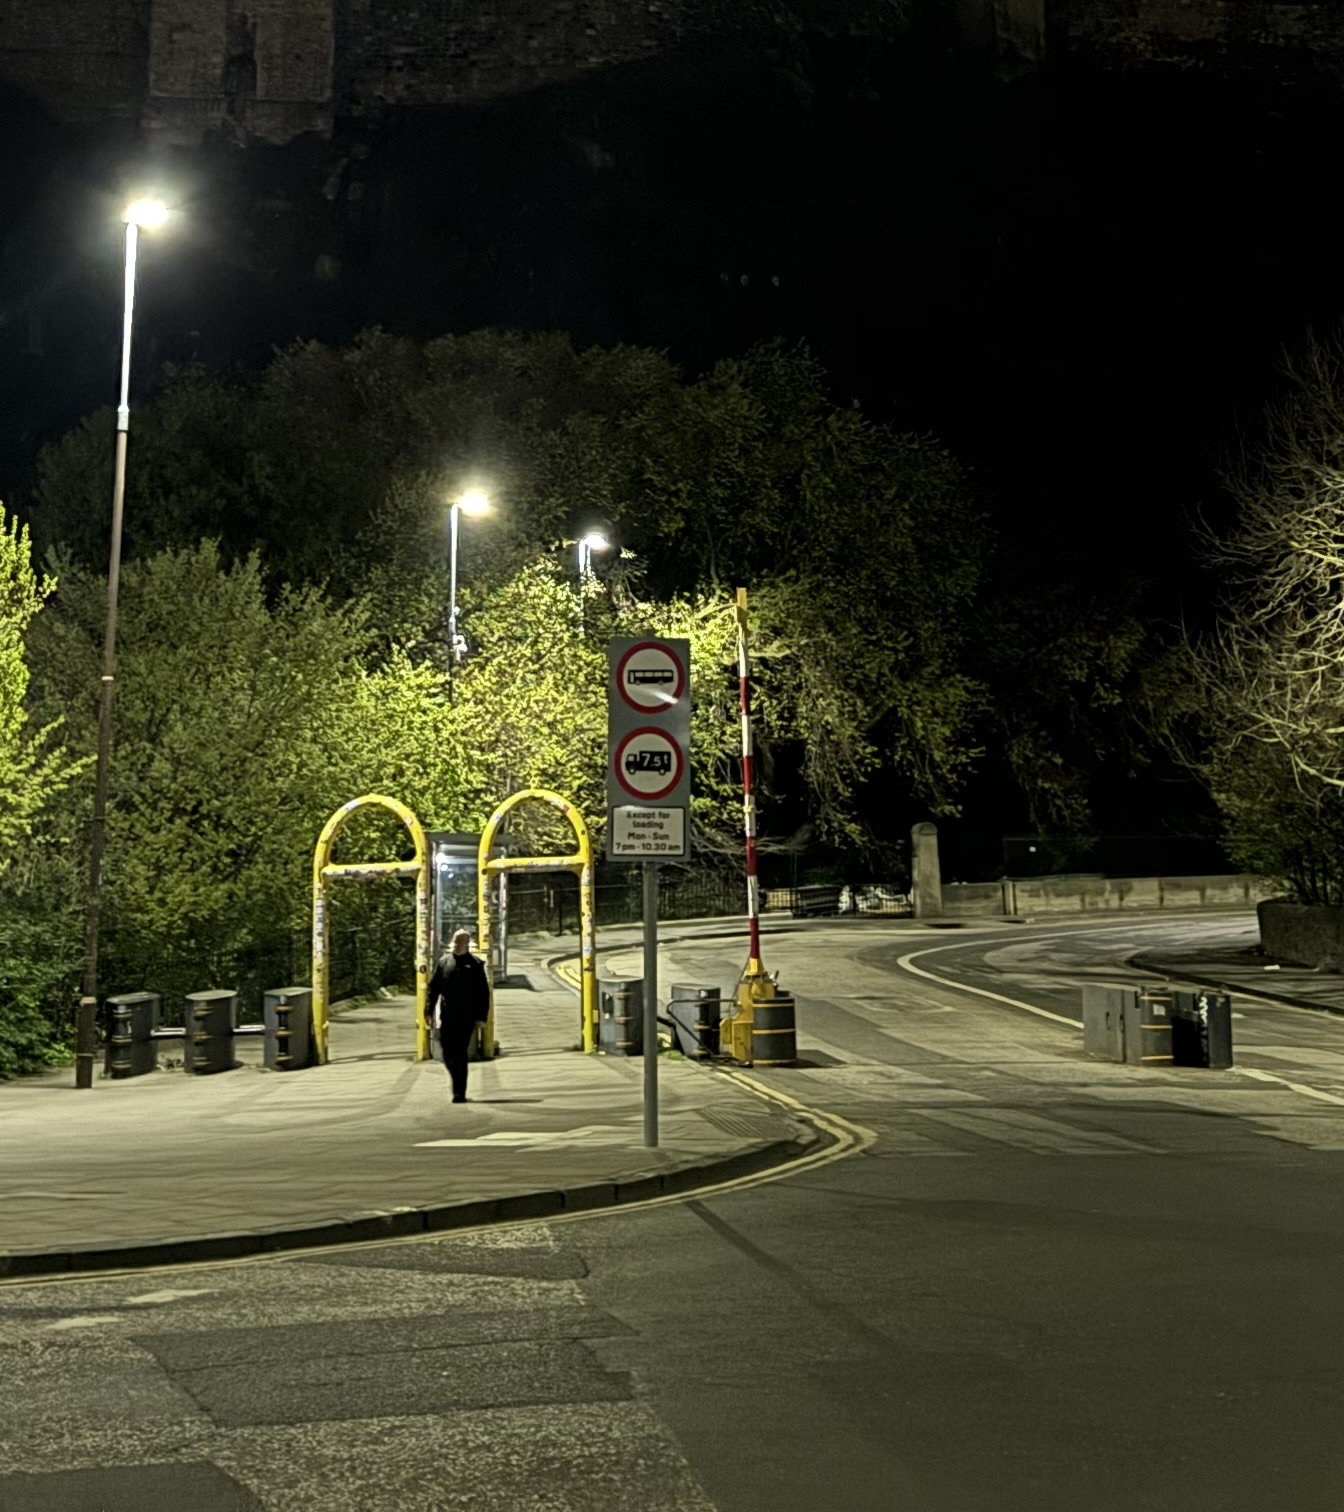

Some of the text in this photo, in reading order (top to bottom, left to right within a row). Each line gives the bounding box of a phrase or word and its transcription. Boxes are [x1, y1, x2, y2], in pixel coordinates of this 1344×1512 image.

[626, 811, 670, 819] Except for
[632, 821, 664, 829] loading
[627, 832, 646, 840] Mon
[653, 832, 670, 840] Sun
